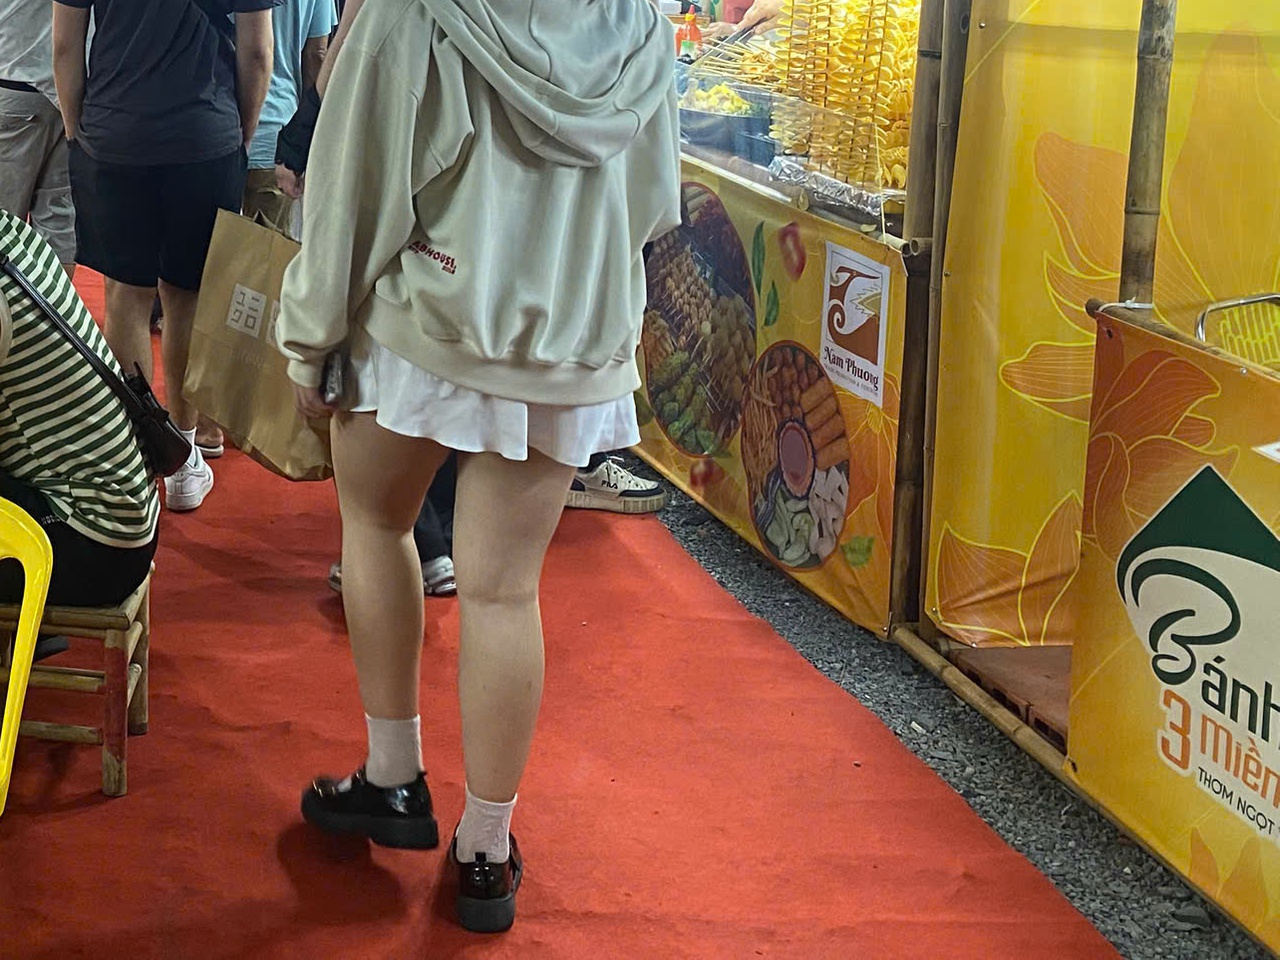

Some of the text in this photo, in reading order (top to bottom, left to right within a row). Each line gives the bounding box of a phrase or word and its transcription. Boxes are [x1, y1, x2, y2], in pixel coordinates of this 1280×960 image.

[824, 346, 844, 369] Nam
[845, 358, 879, 391] Phuong
[1160, 689, 1280, 809] 3 miền
[1198, 766, 1276, 835] THƠM NGỌT
